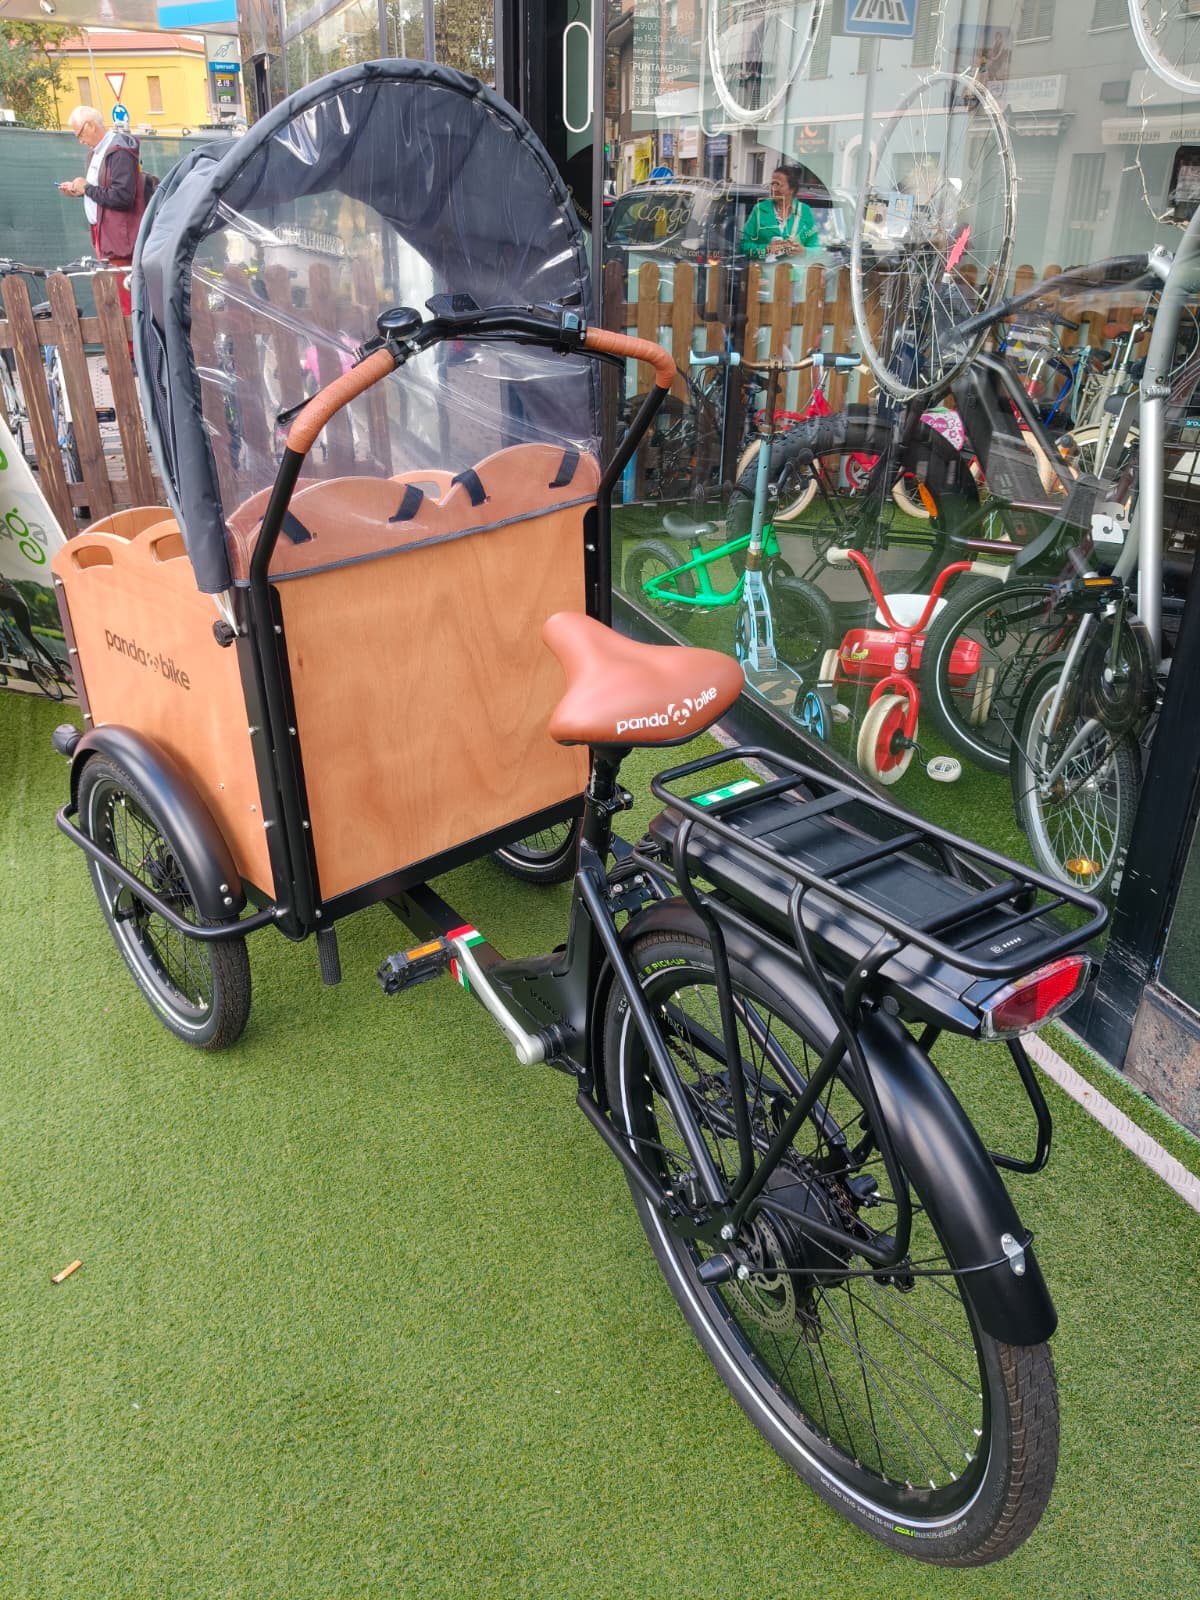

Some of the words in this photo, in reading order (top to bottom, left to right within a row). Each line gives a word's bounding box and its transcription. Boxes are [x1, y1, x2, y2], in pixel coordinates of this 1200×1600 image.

[638, 205, 691, 233] cargo
[104, 629, 147, 666] panda
[159, 653, 191, 690] bike
[616, 713, 669, 734] panda
[693, 687, 717, 711] bike
[651, 958, 686, 971] PICK-UP
